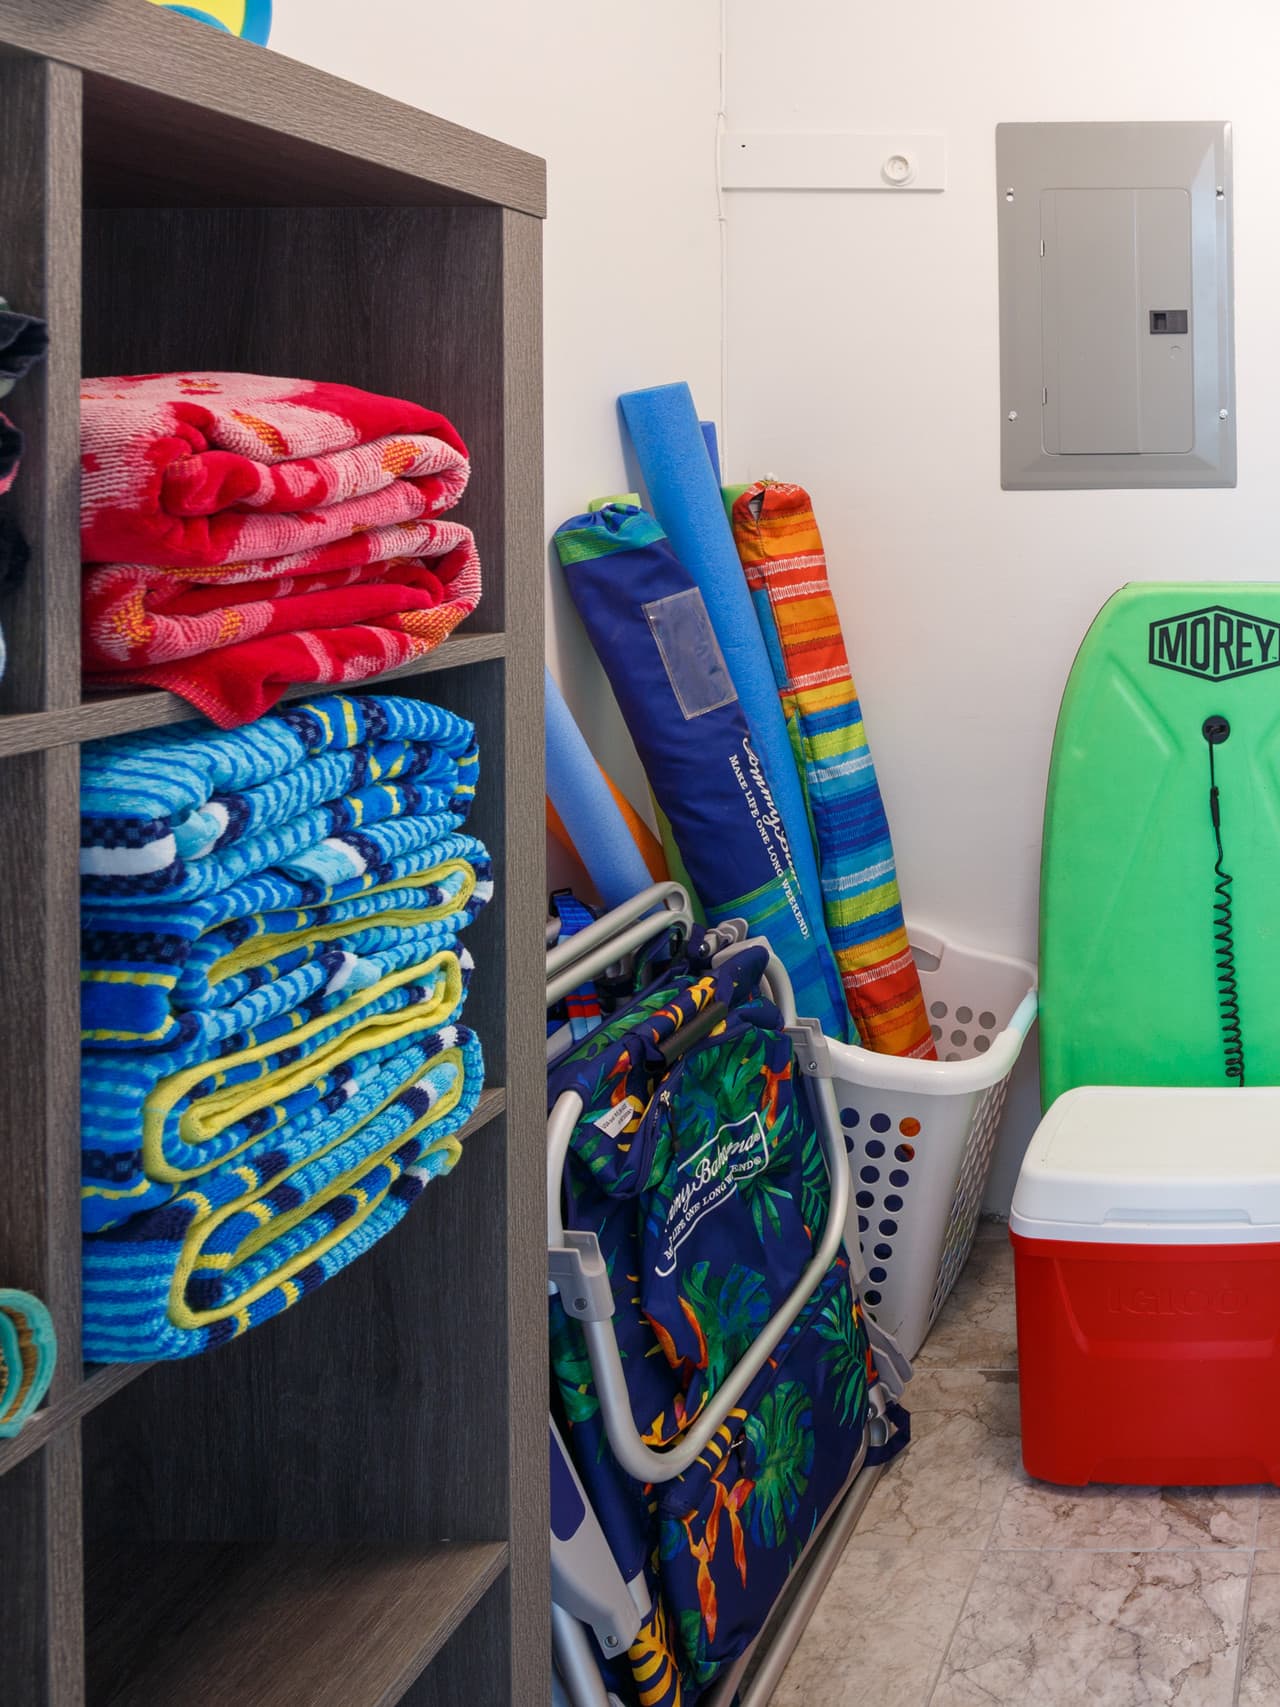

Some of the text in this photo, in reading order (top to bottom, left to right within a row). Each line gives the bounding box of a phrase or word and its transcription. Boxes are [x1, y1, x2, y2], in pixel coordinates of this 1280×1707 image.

[1157, 612, 1276, 675] MOREY
[729, 754, 748, 790] MAKE
[745, 790, 760, 818] LIFE
[756, 819, 770, 845] ONE
[767, 845, 785, 878] LONG
[702, 1182, 727, 1207] LONG
